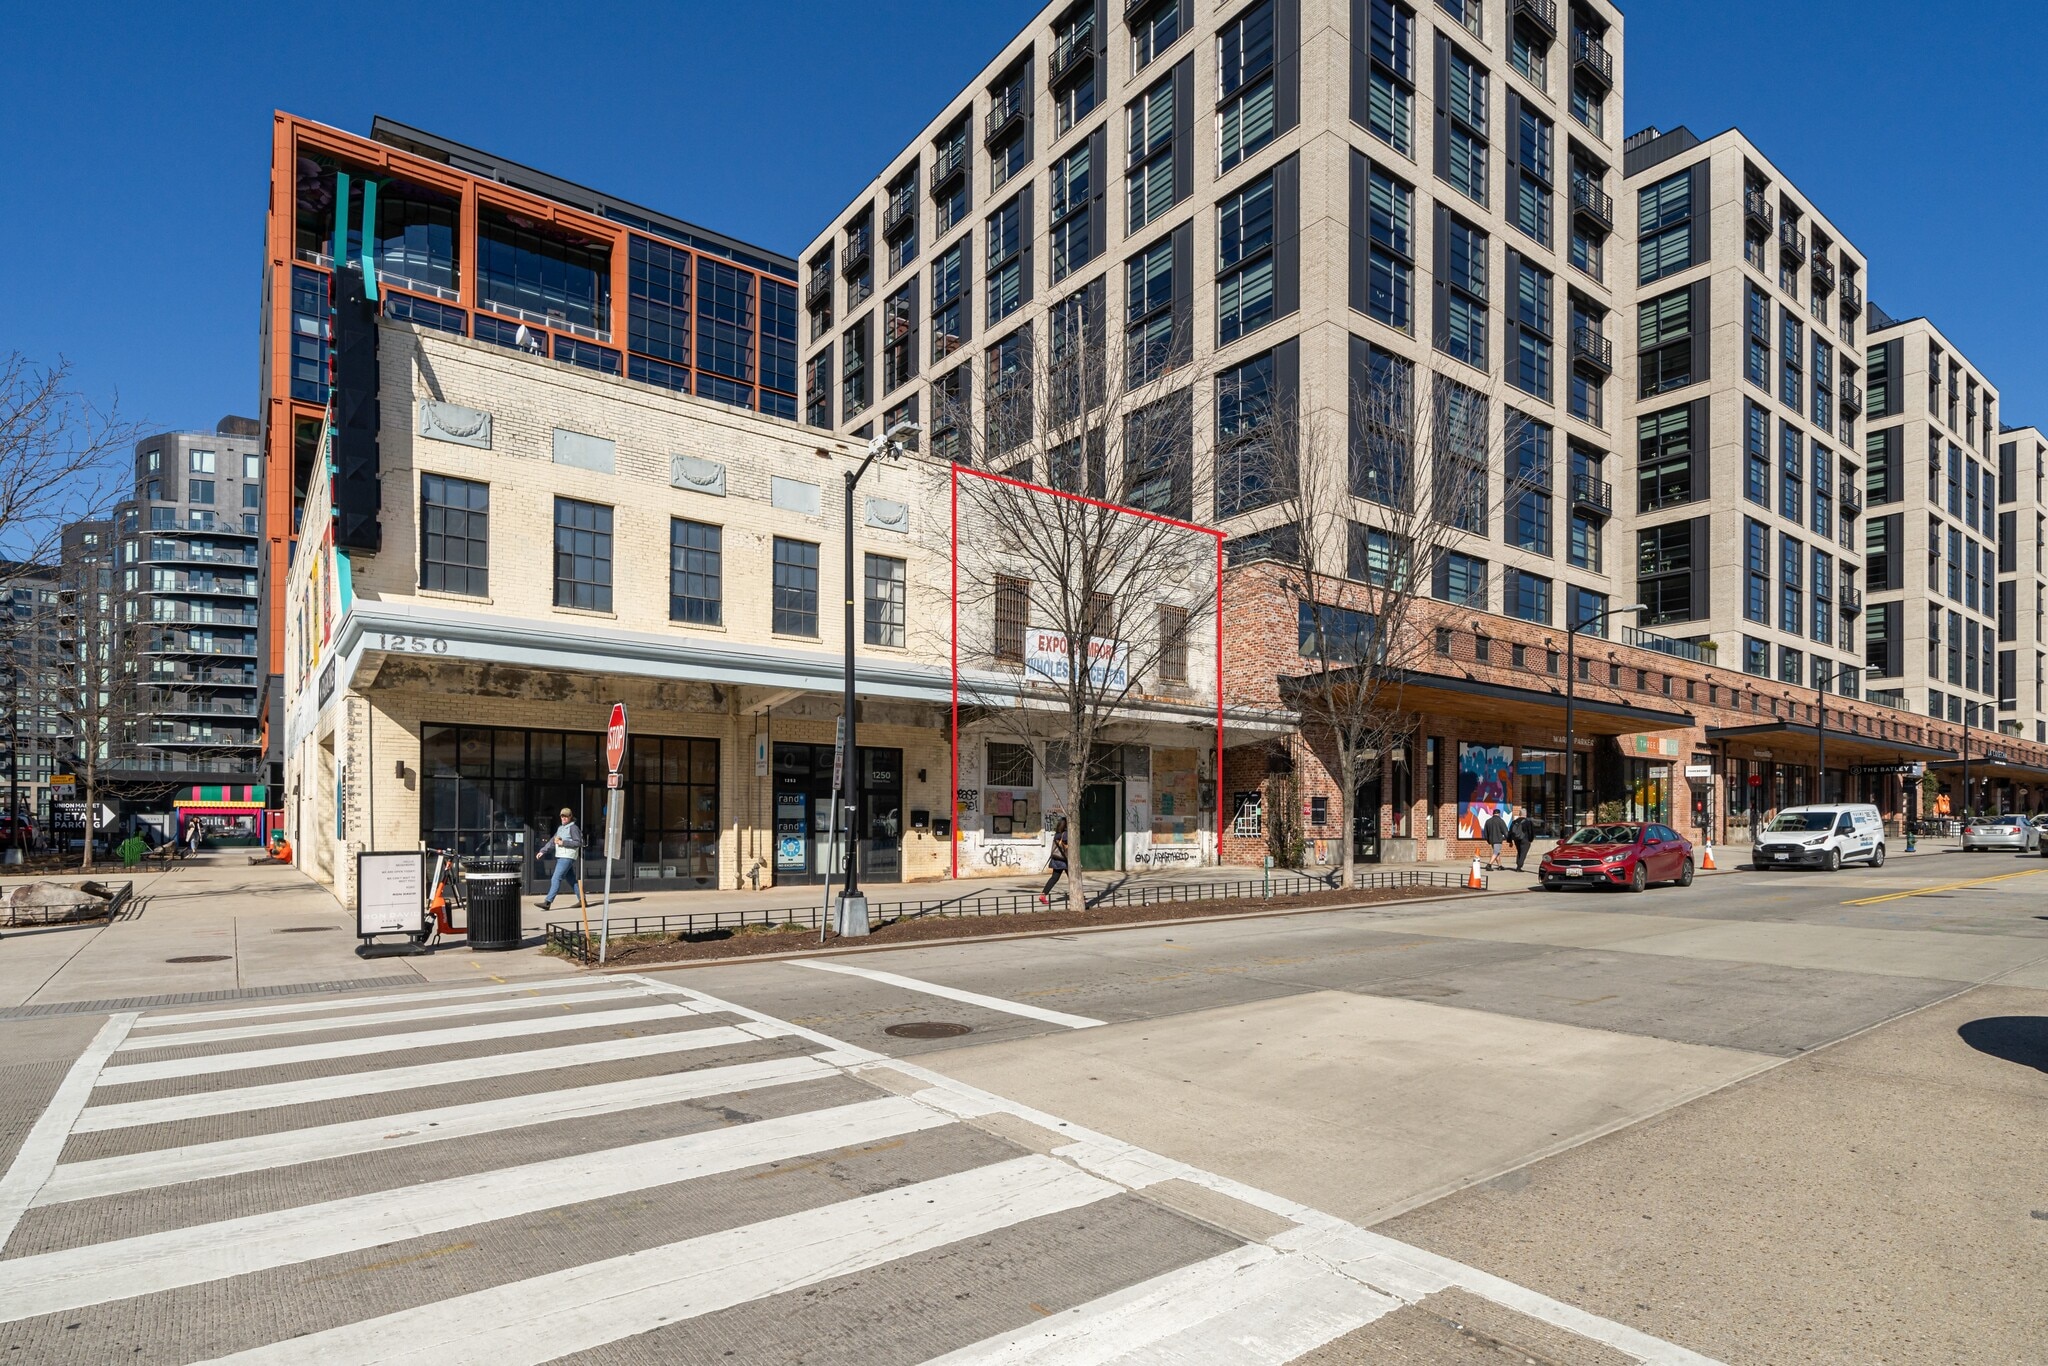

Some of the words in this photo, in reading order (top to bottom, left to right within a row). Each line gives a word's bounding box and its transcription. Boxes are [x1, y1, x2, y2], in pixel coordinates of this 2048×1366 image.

[379, 632, 448, 654] 1250
[1038, 635, 1081, 656] EXPOT
[608, 725, 624, 751] STOP
[1880, 765, 1909, 773] BATLEY
[872, 771, 891, 779] 1250
[778, 794, 799, 803] rand
[54, 812, 101, 821] RETAL
[54, 821, 101, 829] PARKIG
[778, 822, 799, 831] rand
